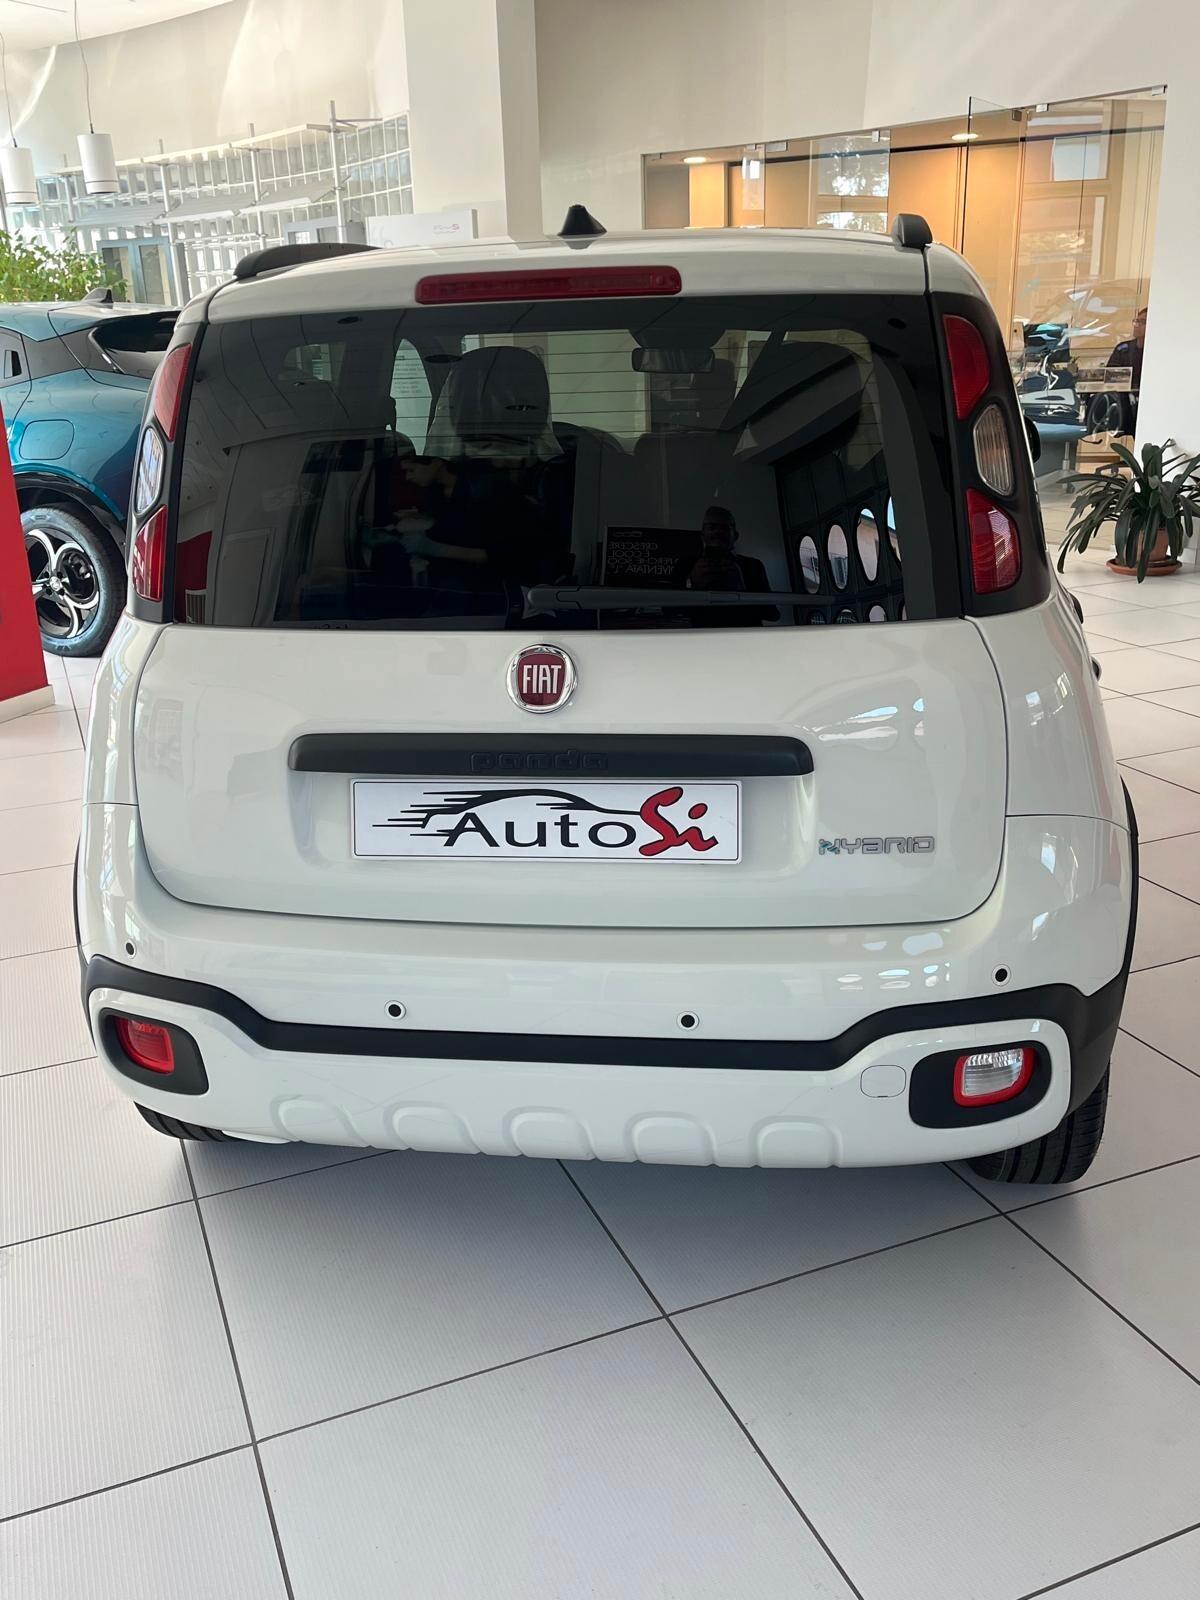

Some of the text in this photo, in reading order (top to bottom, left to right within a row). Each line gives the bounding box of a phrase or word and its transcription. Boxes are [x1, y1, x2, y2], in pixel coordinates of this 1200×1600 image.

[522, 664, 562, 694] FIAT
[470, 748, 609, 772] panda
[818, 836, 935, 855] HYBRID
